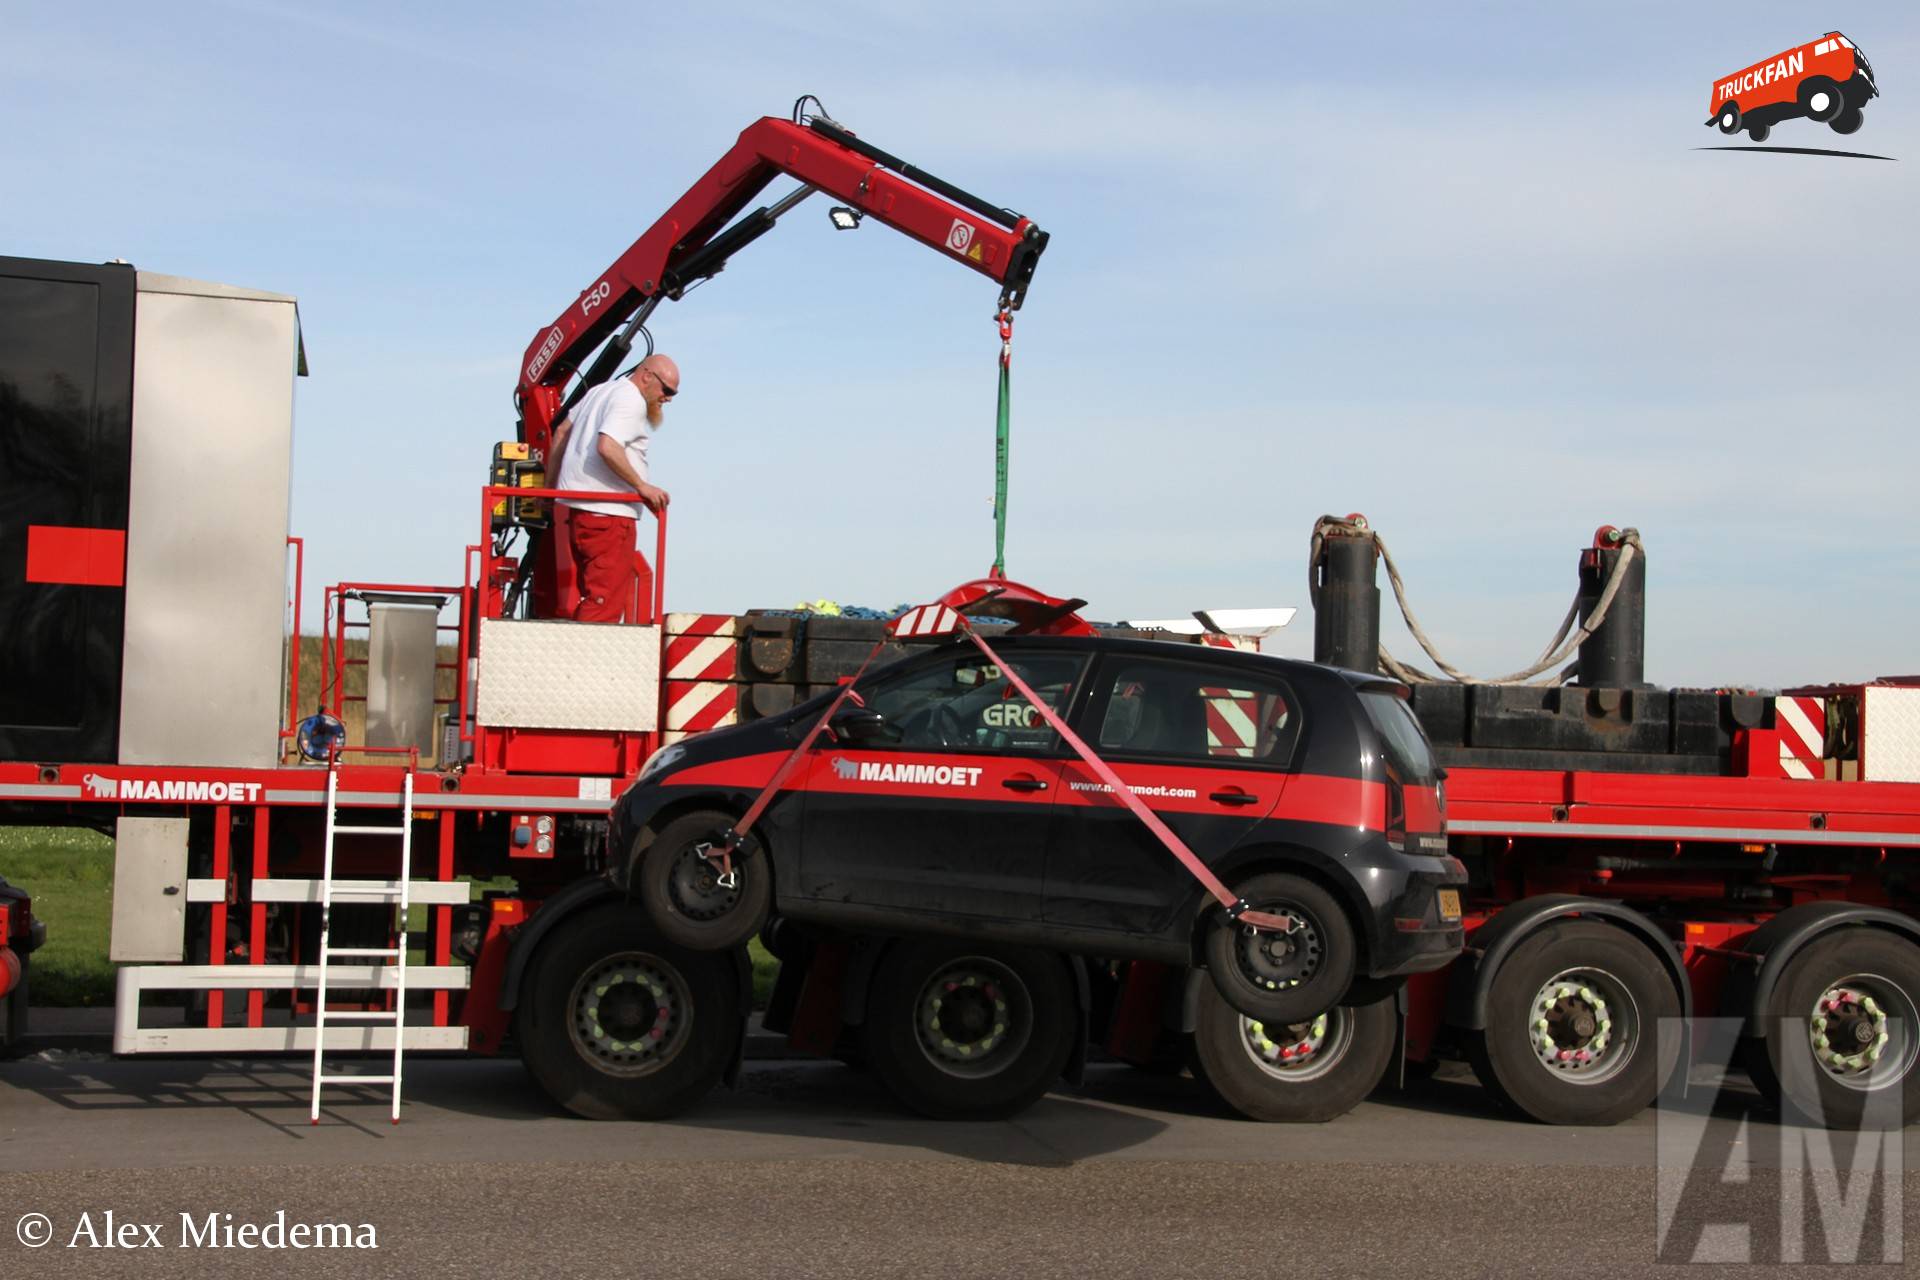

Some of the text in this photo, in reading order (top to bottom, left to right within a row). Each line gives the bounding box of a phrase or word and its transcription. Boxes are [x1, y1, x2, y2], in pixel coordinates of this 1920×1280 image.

[581, 281, 610, 316] F50
[529, 329, 562, 377] FASSI
[859, 762, 983, 786] MAMMOET
[120, 779, 262, 802] MAMMOET
[1069, 781, 1197, 798] www.mmoet.com
